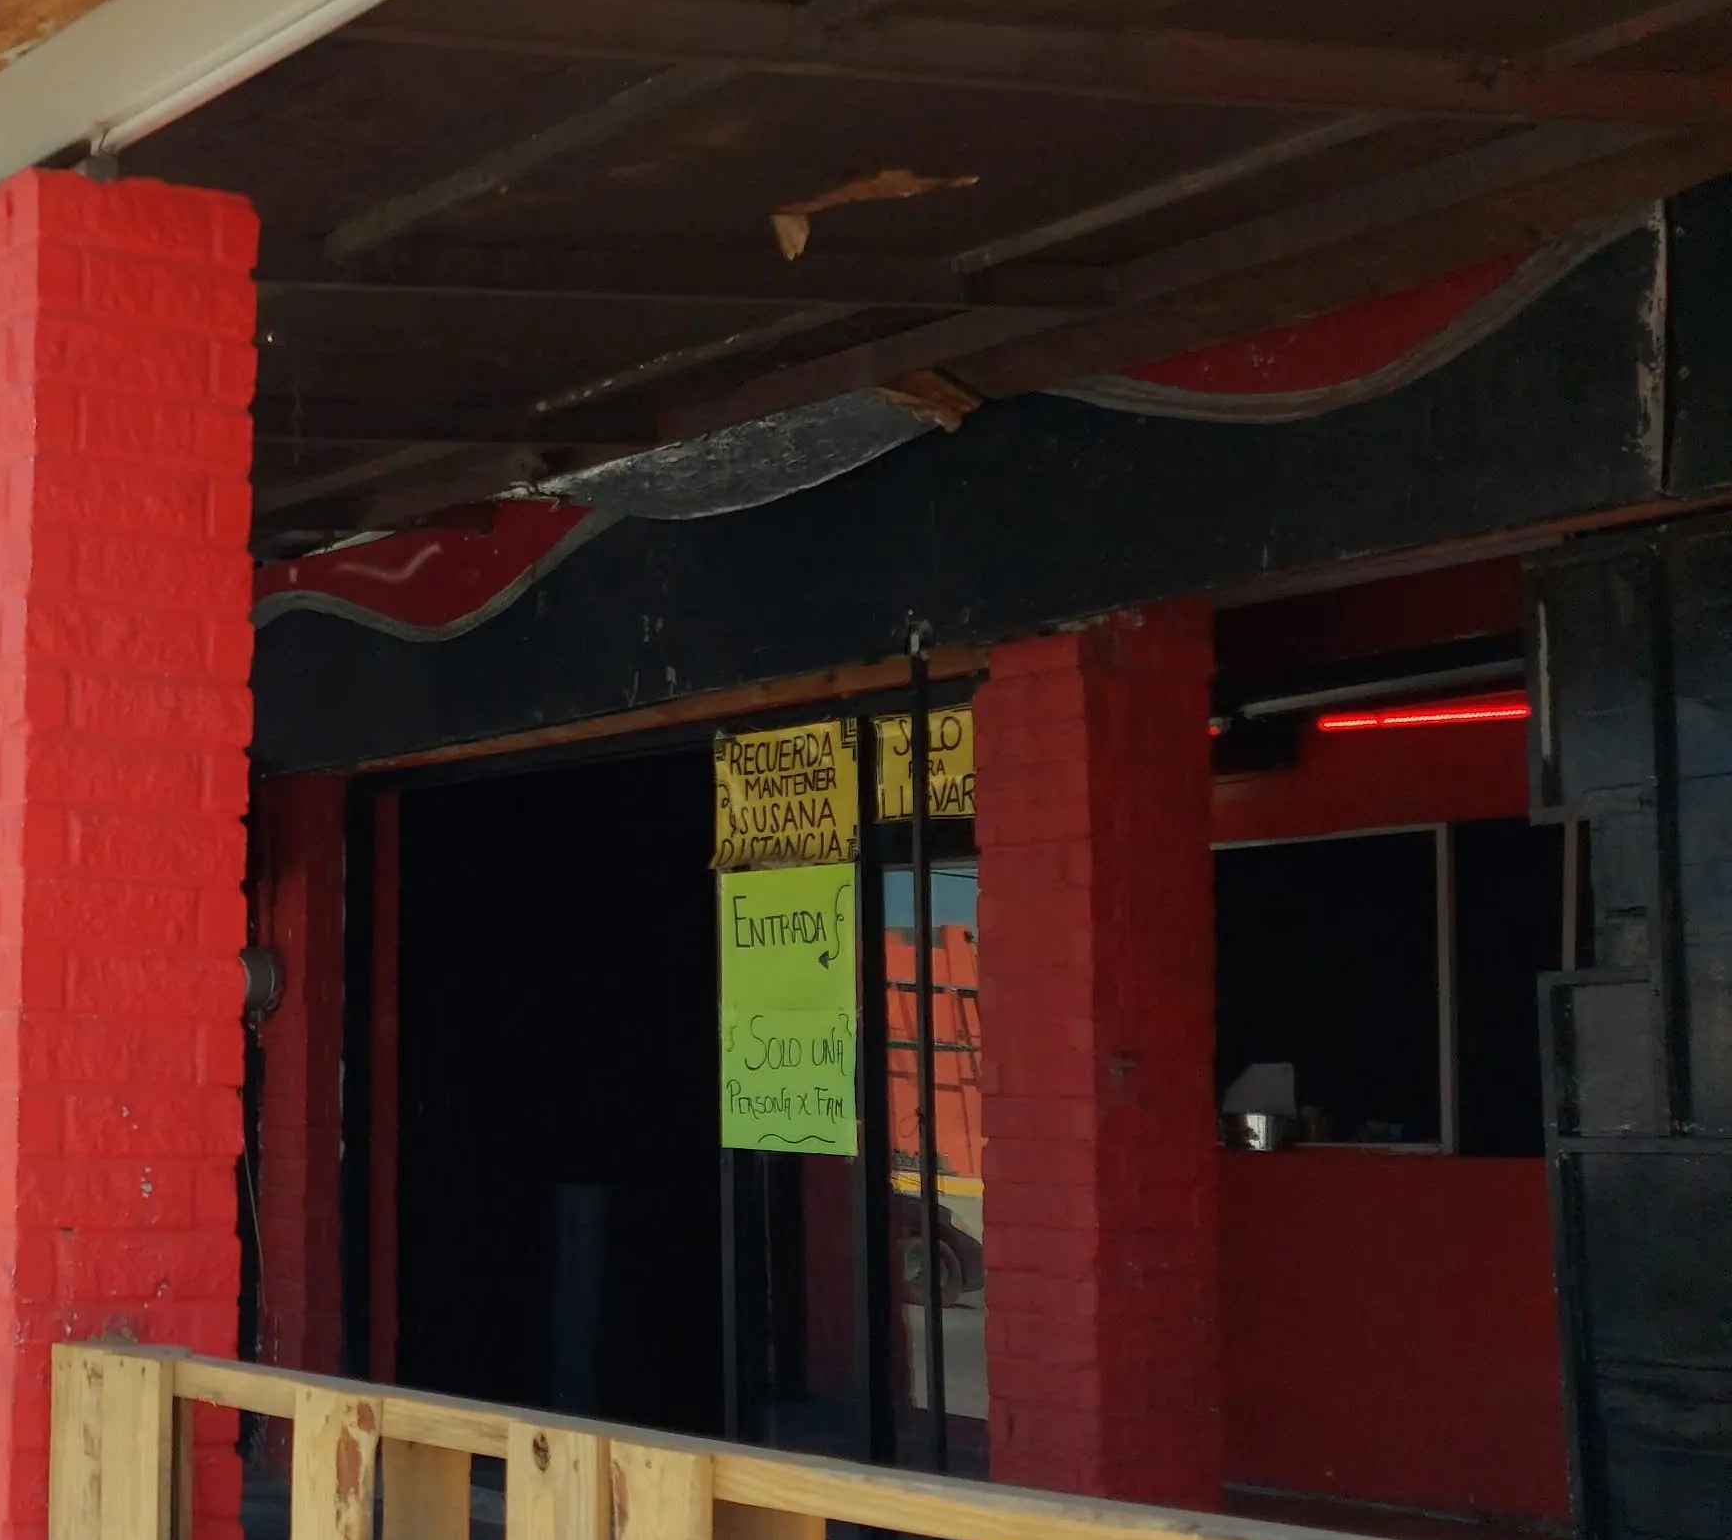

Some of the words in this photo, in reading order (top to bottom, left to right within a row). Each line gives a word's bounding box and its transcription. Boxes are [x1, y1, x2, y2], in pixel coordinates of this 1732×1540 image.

[729, 731, 835, 776] RECUERDA
[893, 716, 962, 756] SLO
[744, 767, 837, 801] MANTENER
[908, 758, 947, 779] PRA
[881, 773, 977, 818] LLVAR
[739, 797, 837, 835] SUSANA
[718, 829, 843, 866] DISTANCIA
[732, 895, 828, 949] ENTRADA
